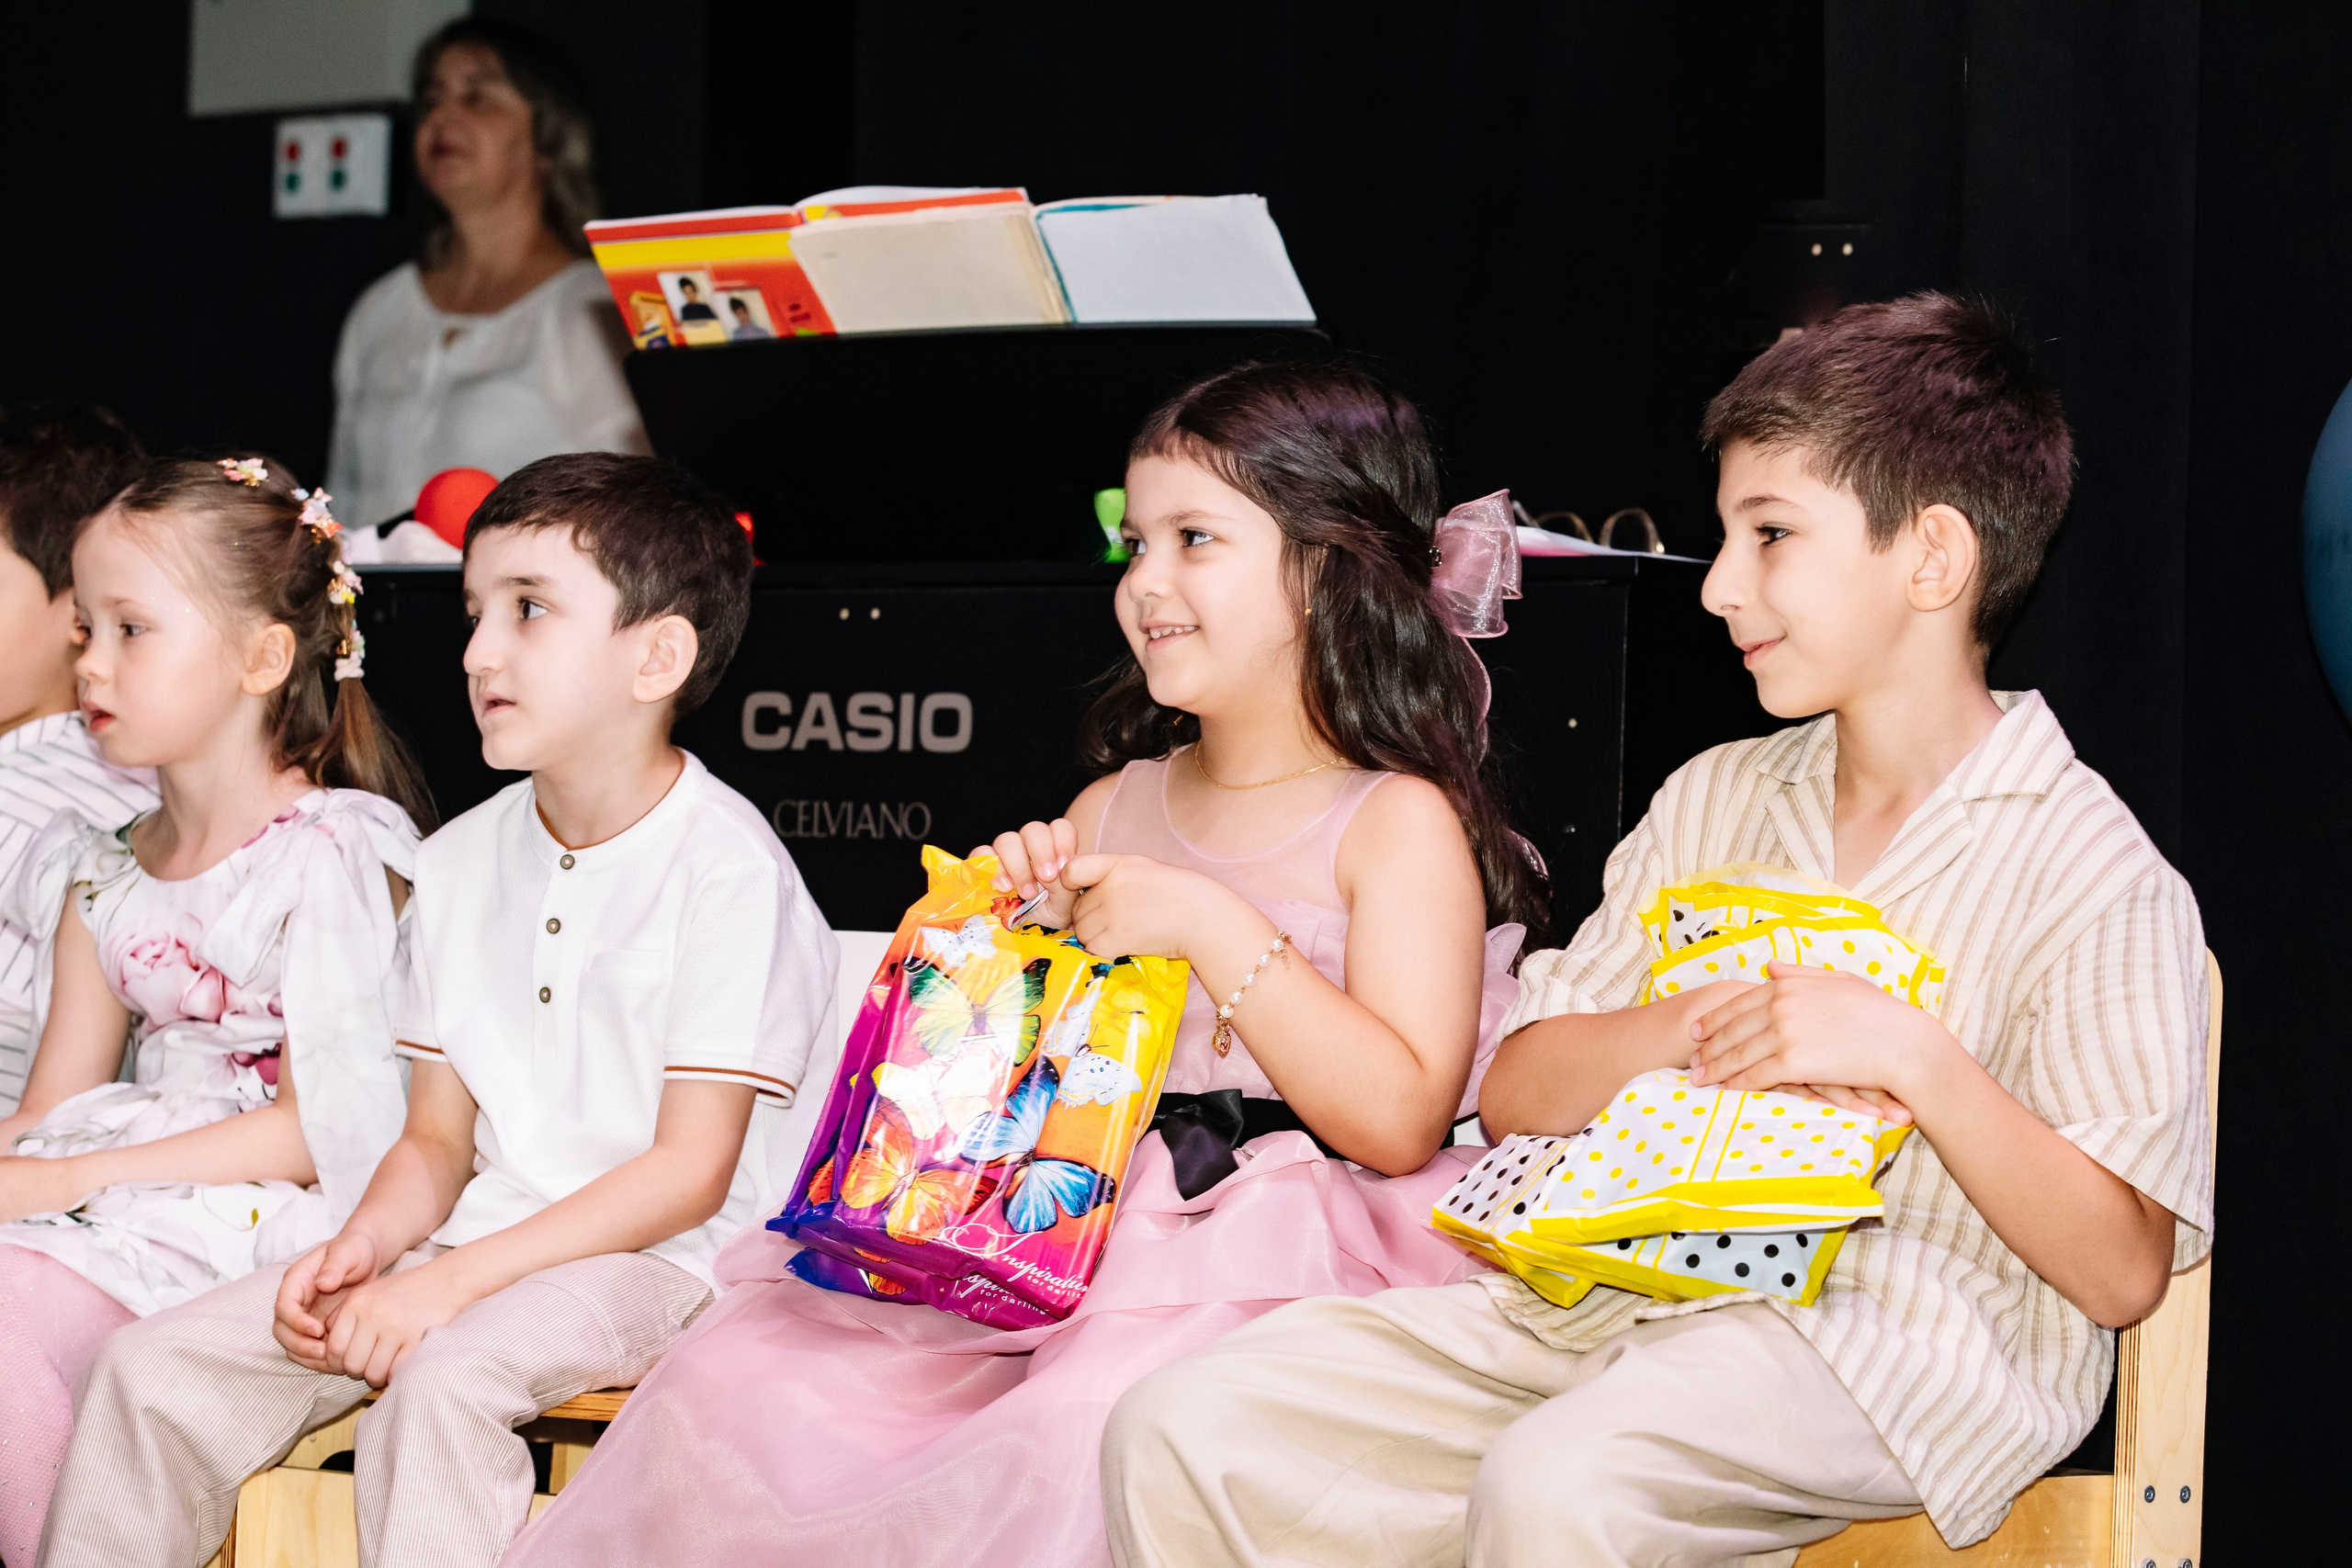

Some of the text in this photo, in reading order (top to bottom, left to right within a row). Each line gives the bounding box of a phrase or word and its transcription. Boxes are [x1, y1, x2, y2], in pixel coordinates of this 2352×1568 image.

[741, 691, 973, 753] CASIO
[773, 799, 932, 841] CELVIANO
[979, 1289, 998, 1298] for
[1027, 1275, 1045, 1286] for
